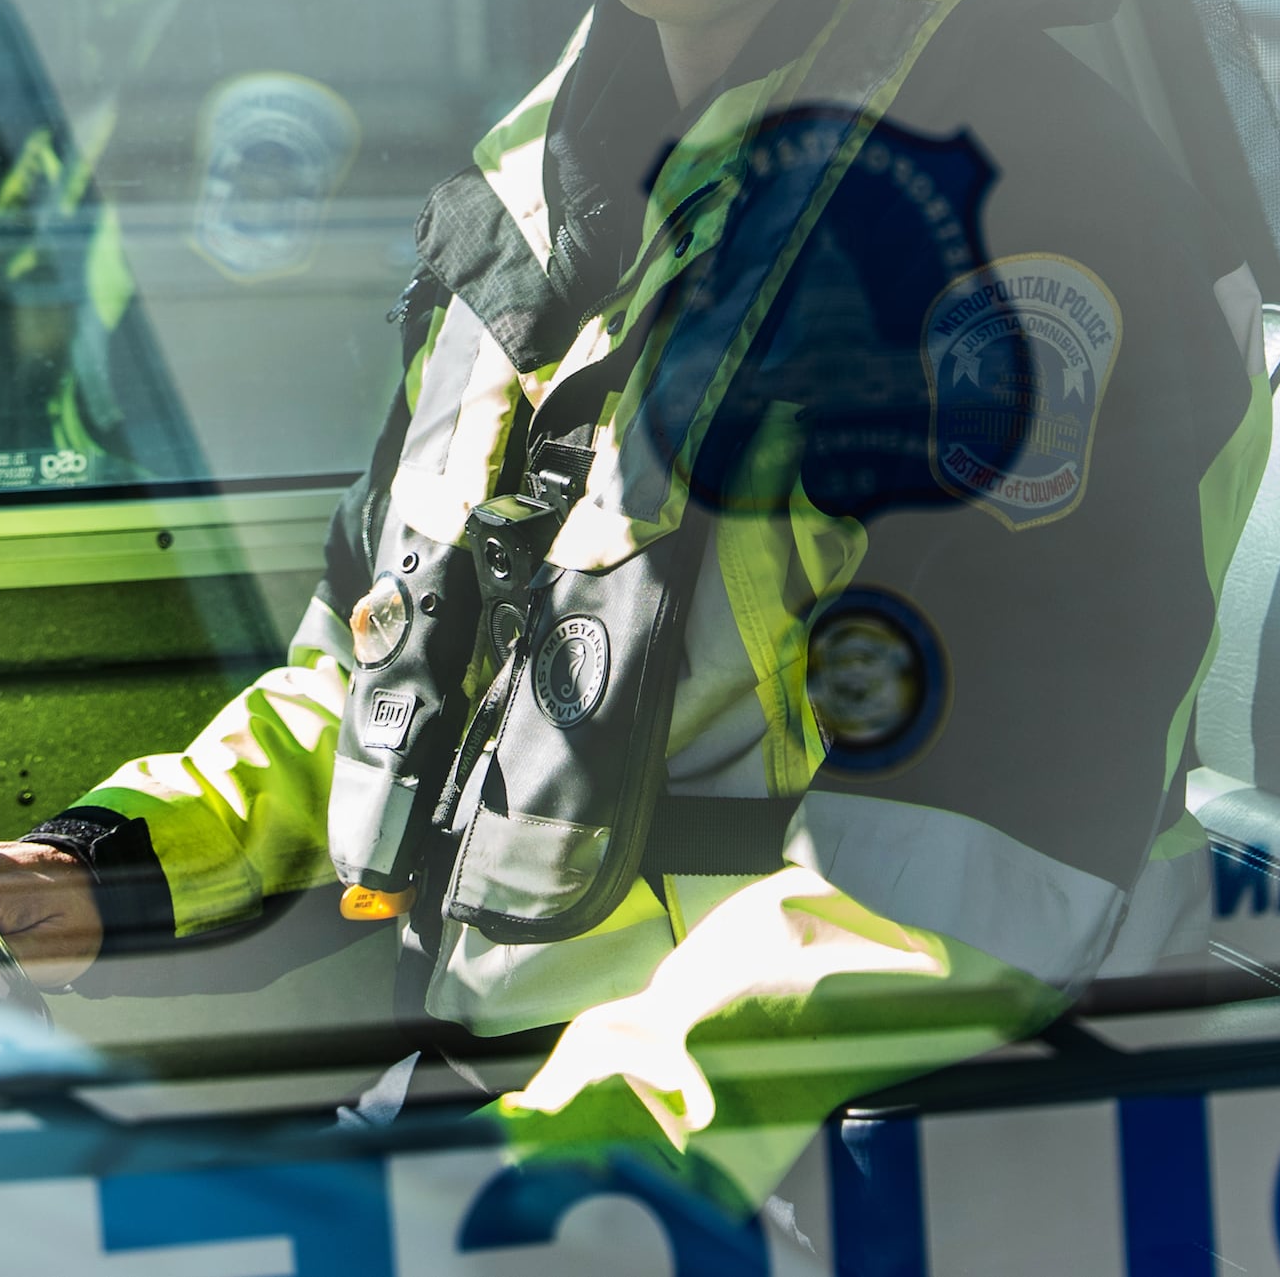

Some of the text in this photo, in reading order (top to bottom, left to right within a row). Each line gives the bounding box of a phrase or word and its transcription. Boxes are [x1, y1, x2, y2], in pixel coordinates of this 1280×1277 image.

[934, 275, 1113, 351] METROPOLITAN POLICE
[1026, 316, 1085, 368] OMNIBUS
[945, 446, 1078, 504] DISTRICT of COLUMBIA
